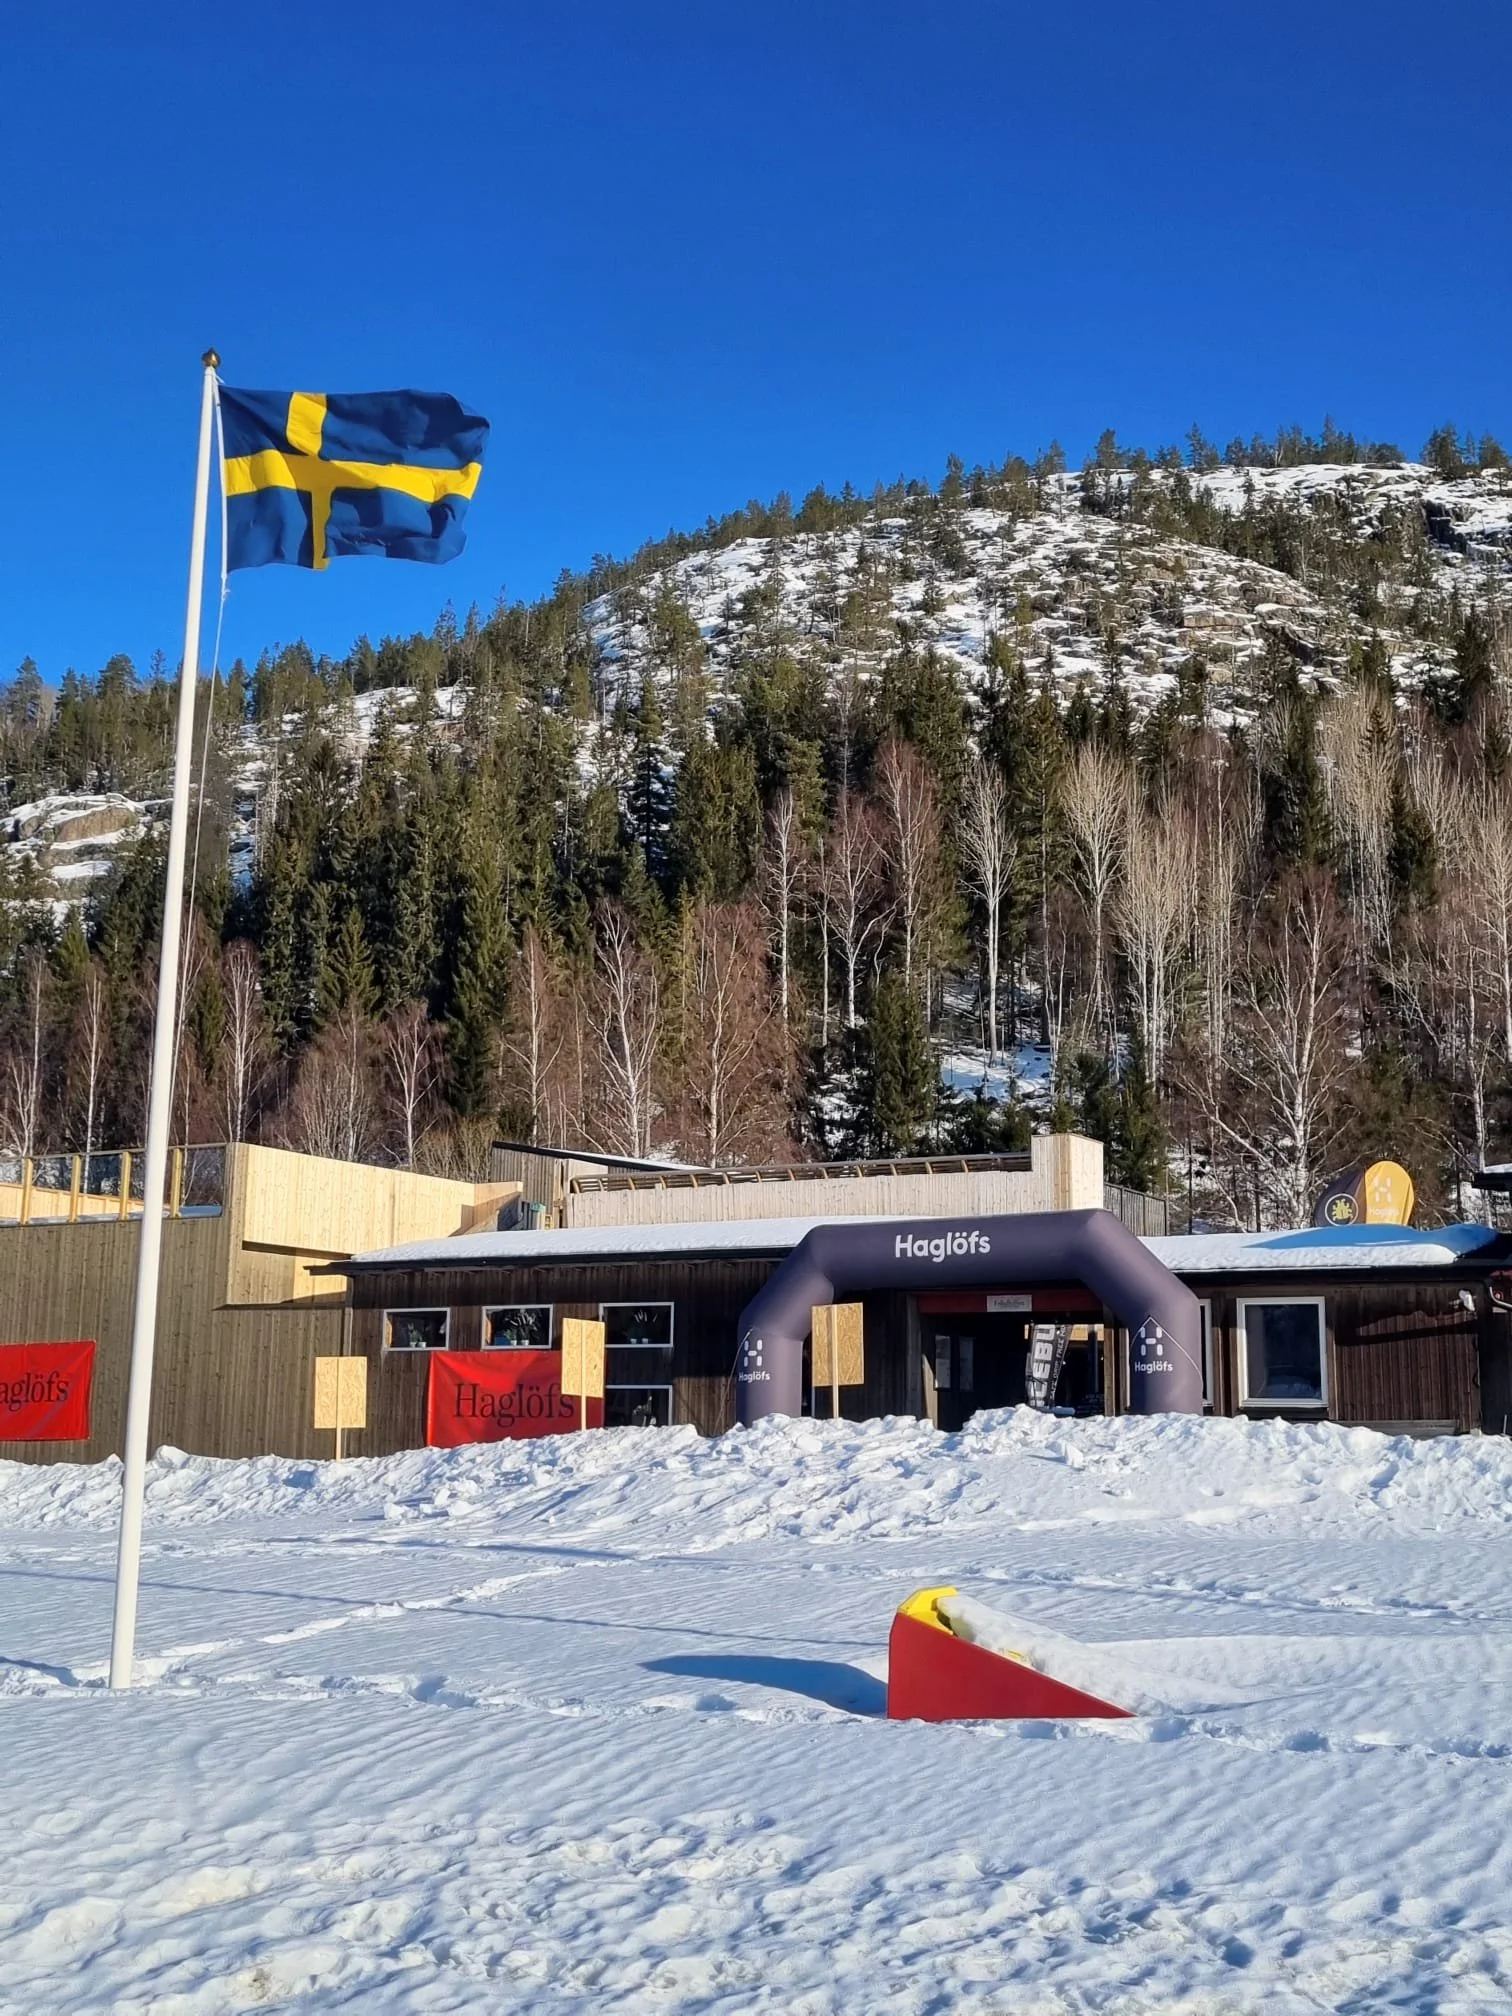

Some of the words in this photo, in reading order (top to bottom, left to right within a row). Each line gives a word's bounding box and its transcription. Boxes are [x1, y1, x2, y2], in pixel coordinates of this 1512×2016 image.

[895, 1230, 991, 1263] Haglöfs
[738, 1371, 771, 1383] Haglöfs
[1134, 1361, 1174, 1374] Haglöfs
[0, 1370, 69, 1412] aglöfs
[455, 1383, 575, 1428] Haglöfs
